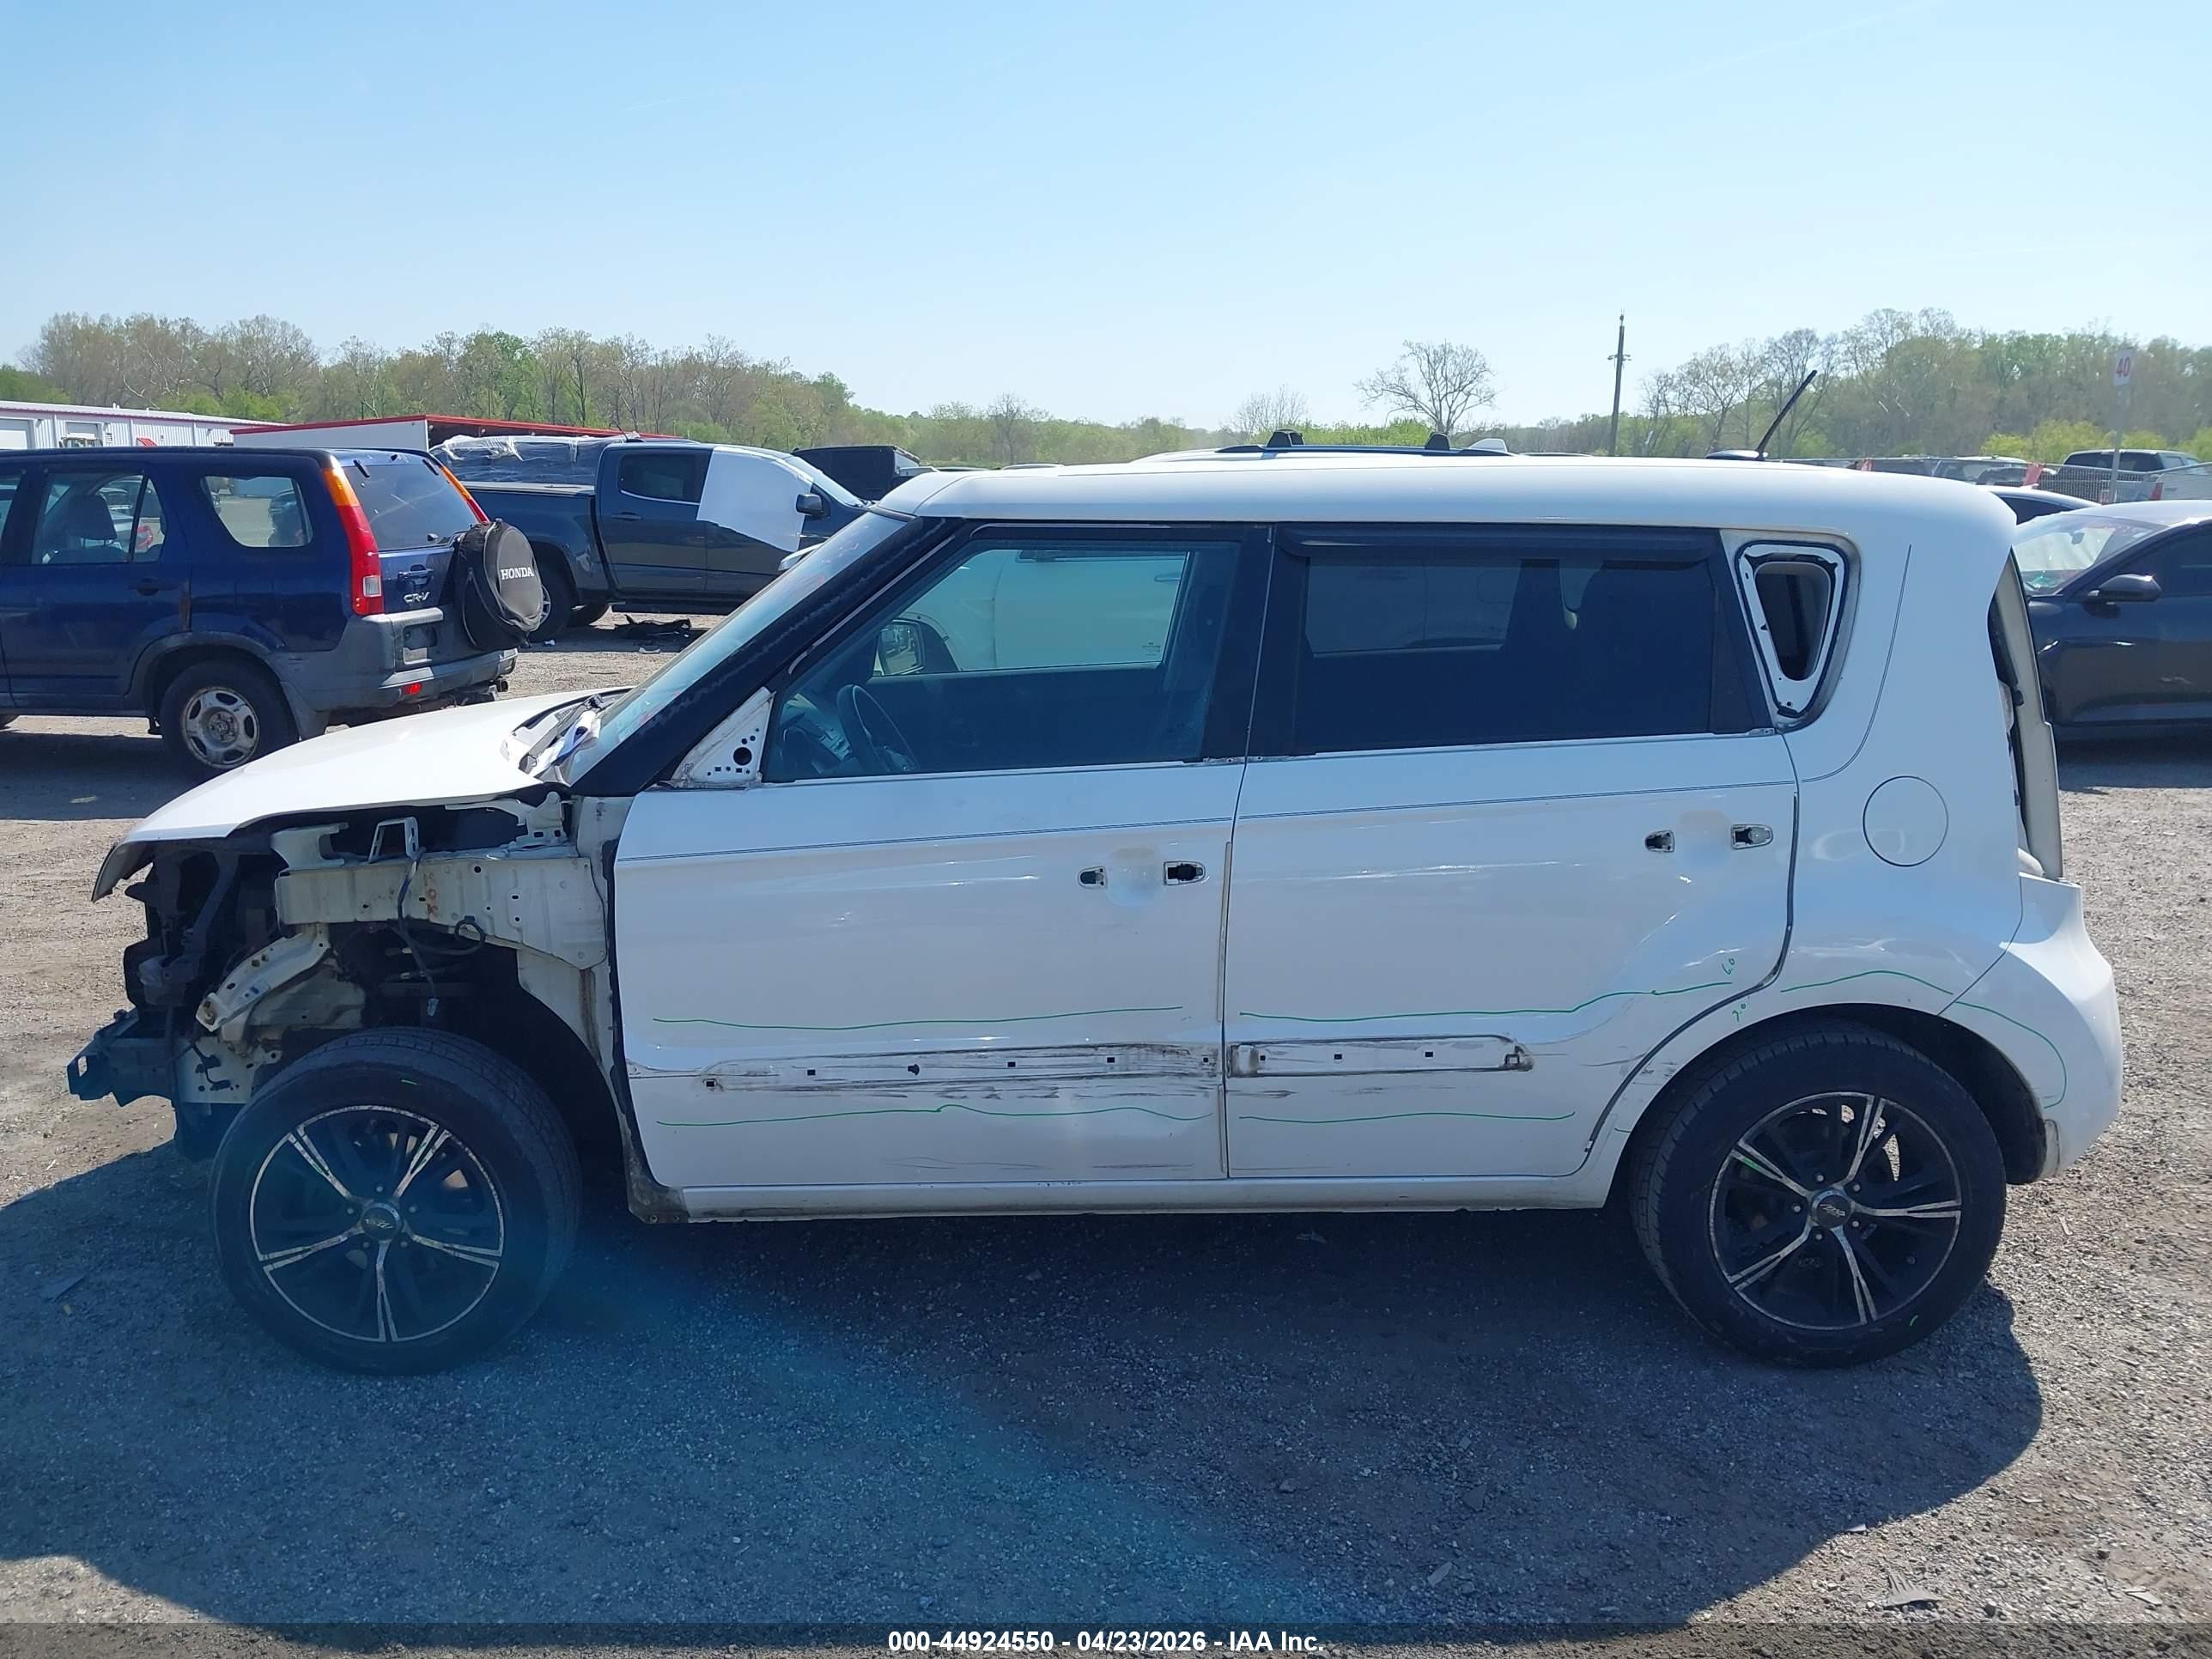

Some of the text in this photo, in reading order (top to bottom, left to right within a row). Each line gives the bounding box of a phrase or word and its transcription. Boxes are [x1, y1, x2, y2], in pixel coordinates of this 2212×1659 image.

[2115, 356, 2130, 378] 40
[501, 567, 534, 580] HONDA
[403, 591, 430, 604] CR-V
